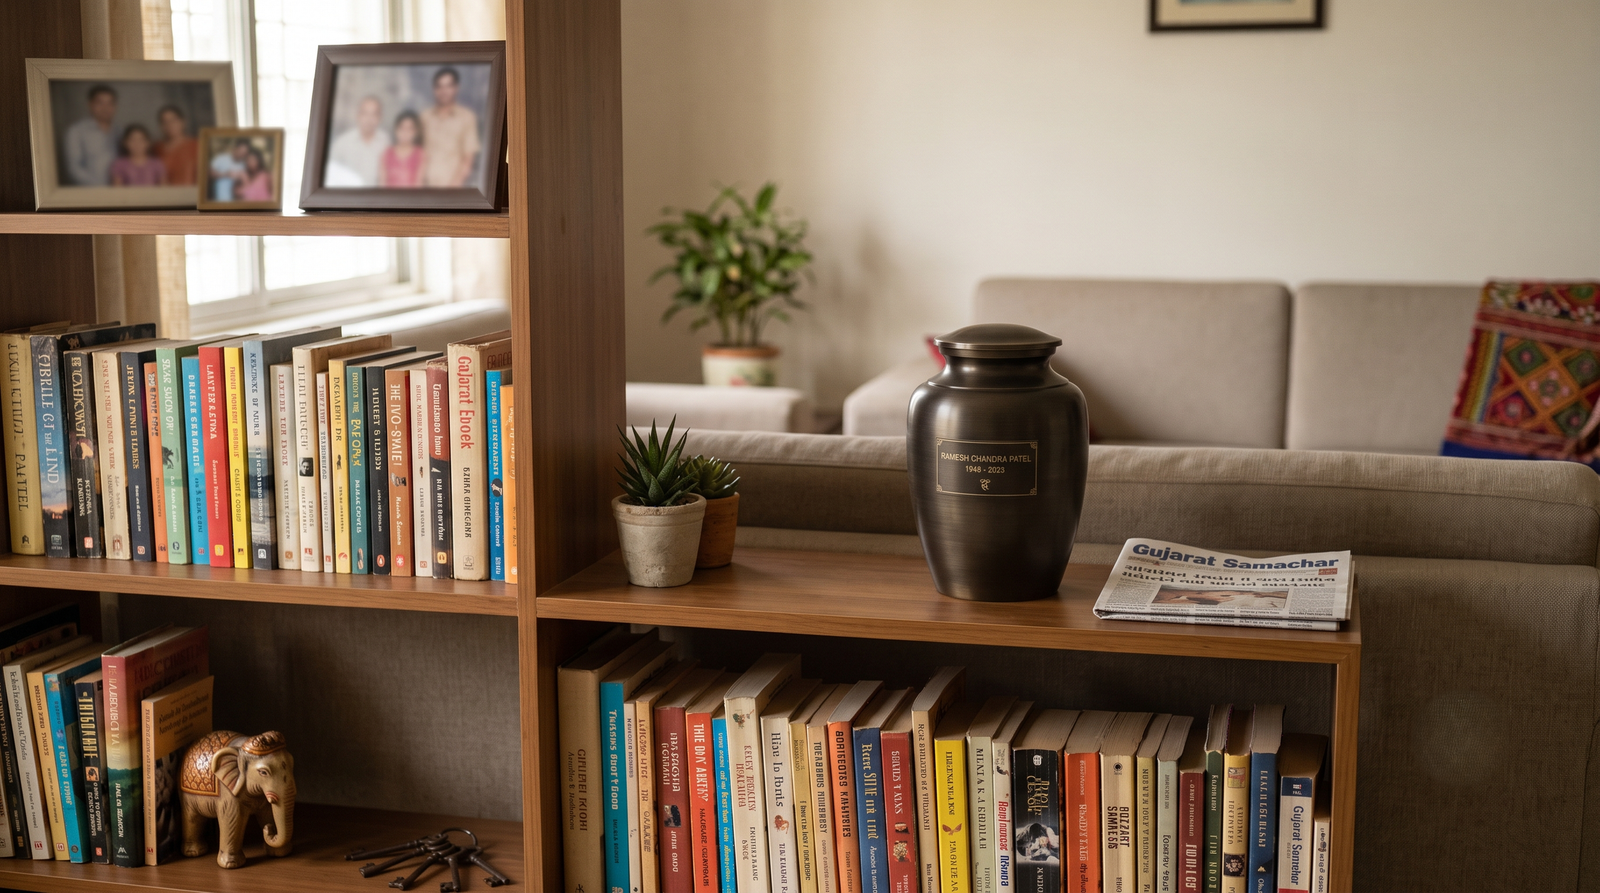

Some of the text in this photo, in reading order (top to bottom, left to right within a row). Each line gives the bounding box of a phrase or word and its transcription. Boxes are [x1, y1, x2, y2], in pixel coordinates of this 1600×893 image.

[941, 452, 1032, 463] RAMESH CHANDRA PATEL
[965, 465, 982, 473] 1948
[988, 466, 1005, 474] 2023
[1132, 543, 1339, 570] Gujarat Samachar
